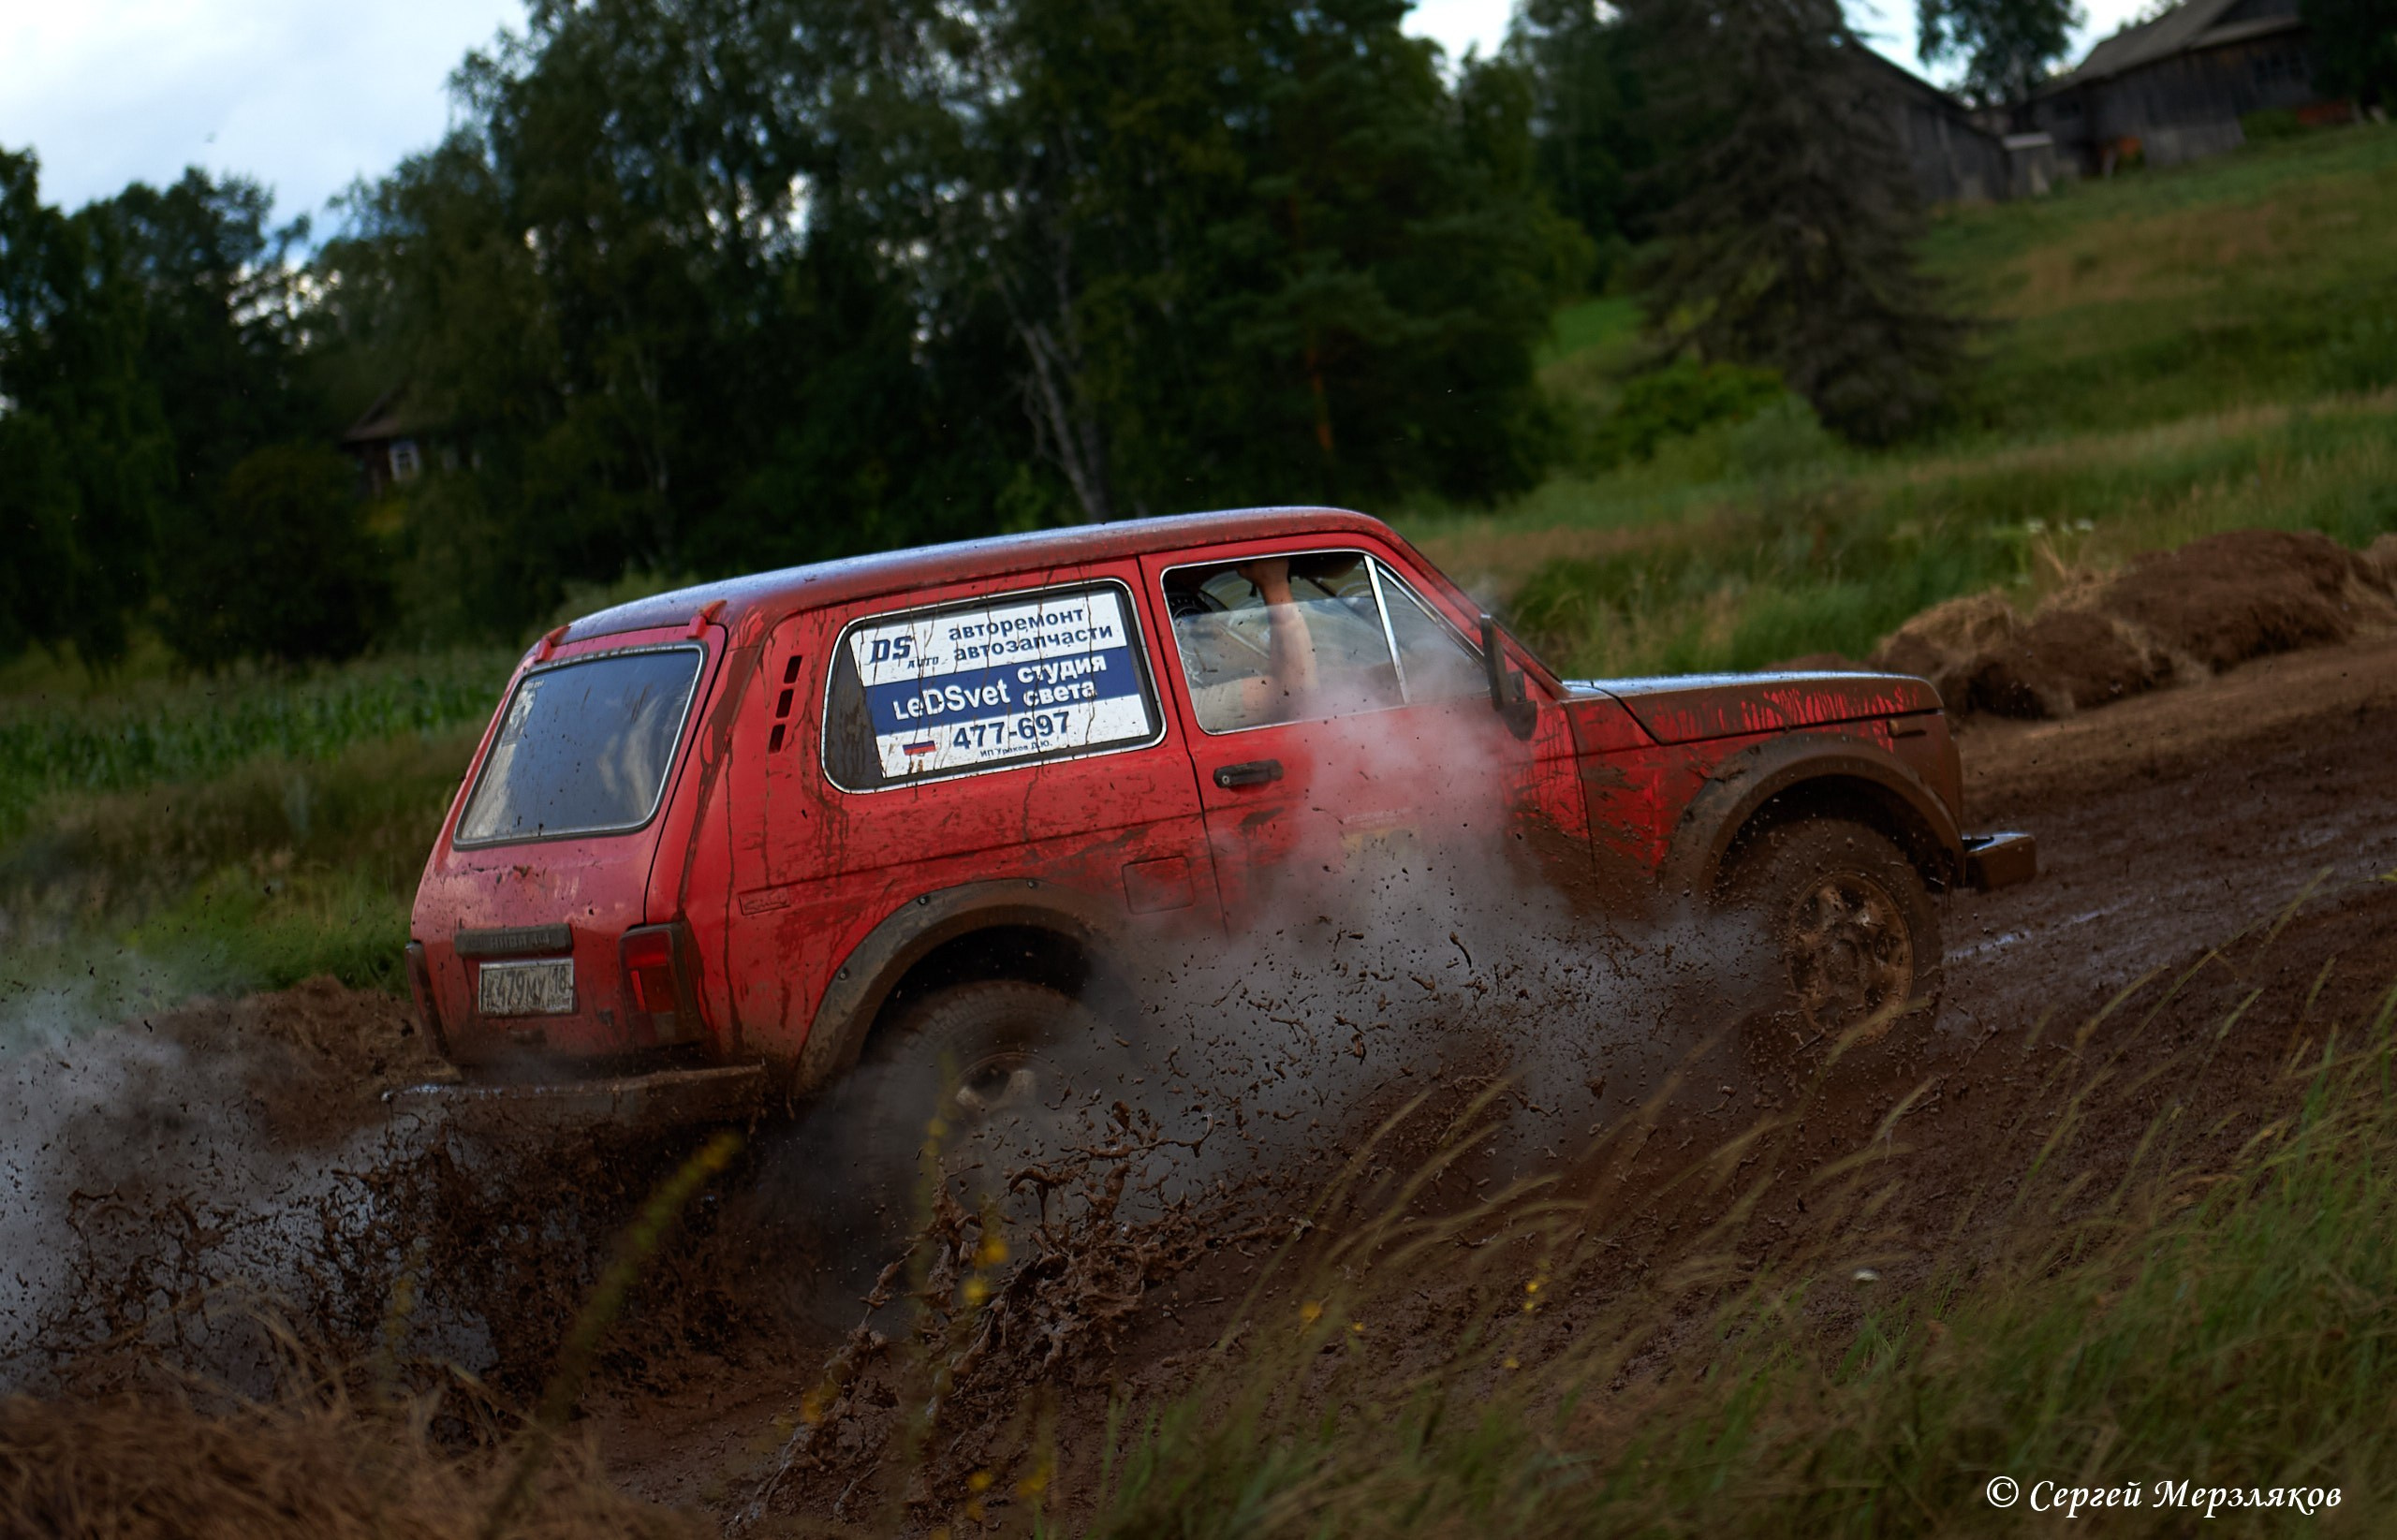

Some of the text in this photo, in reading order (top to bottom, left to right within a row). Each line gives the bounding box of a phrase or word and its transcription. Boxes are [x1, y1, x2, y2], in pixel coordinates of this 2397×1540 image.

[949, 609, 1084, 640] авторемонт
[870, 635, 913, 666] DS
[953, 623, 1113, 661] автозапчасти
[906, 655, 940, 669] AUTO
[1017, 654, 1108, 684] студия
[1022, 680, 1097, 707] света
[953, 711, 1070, 749] 477-697
